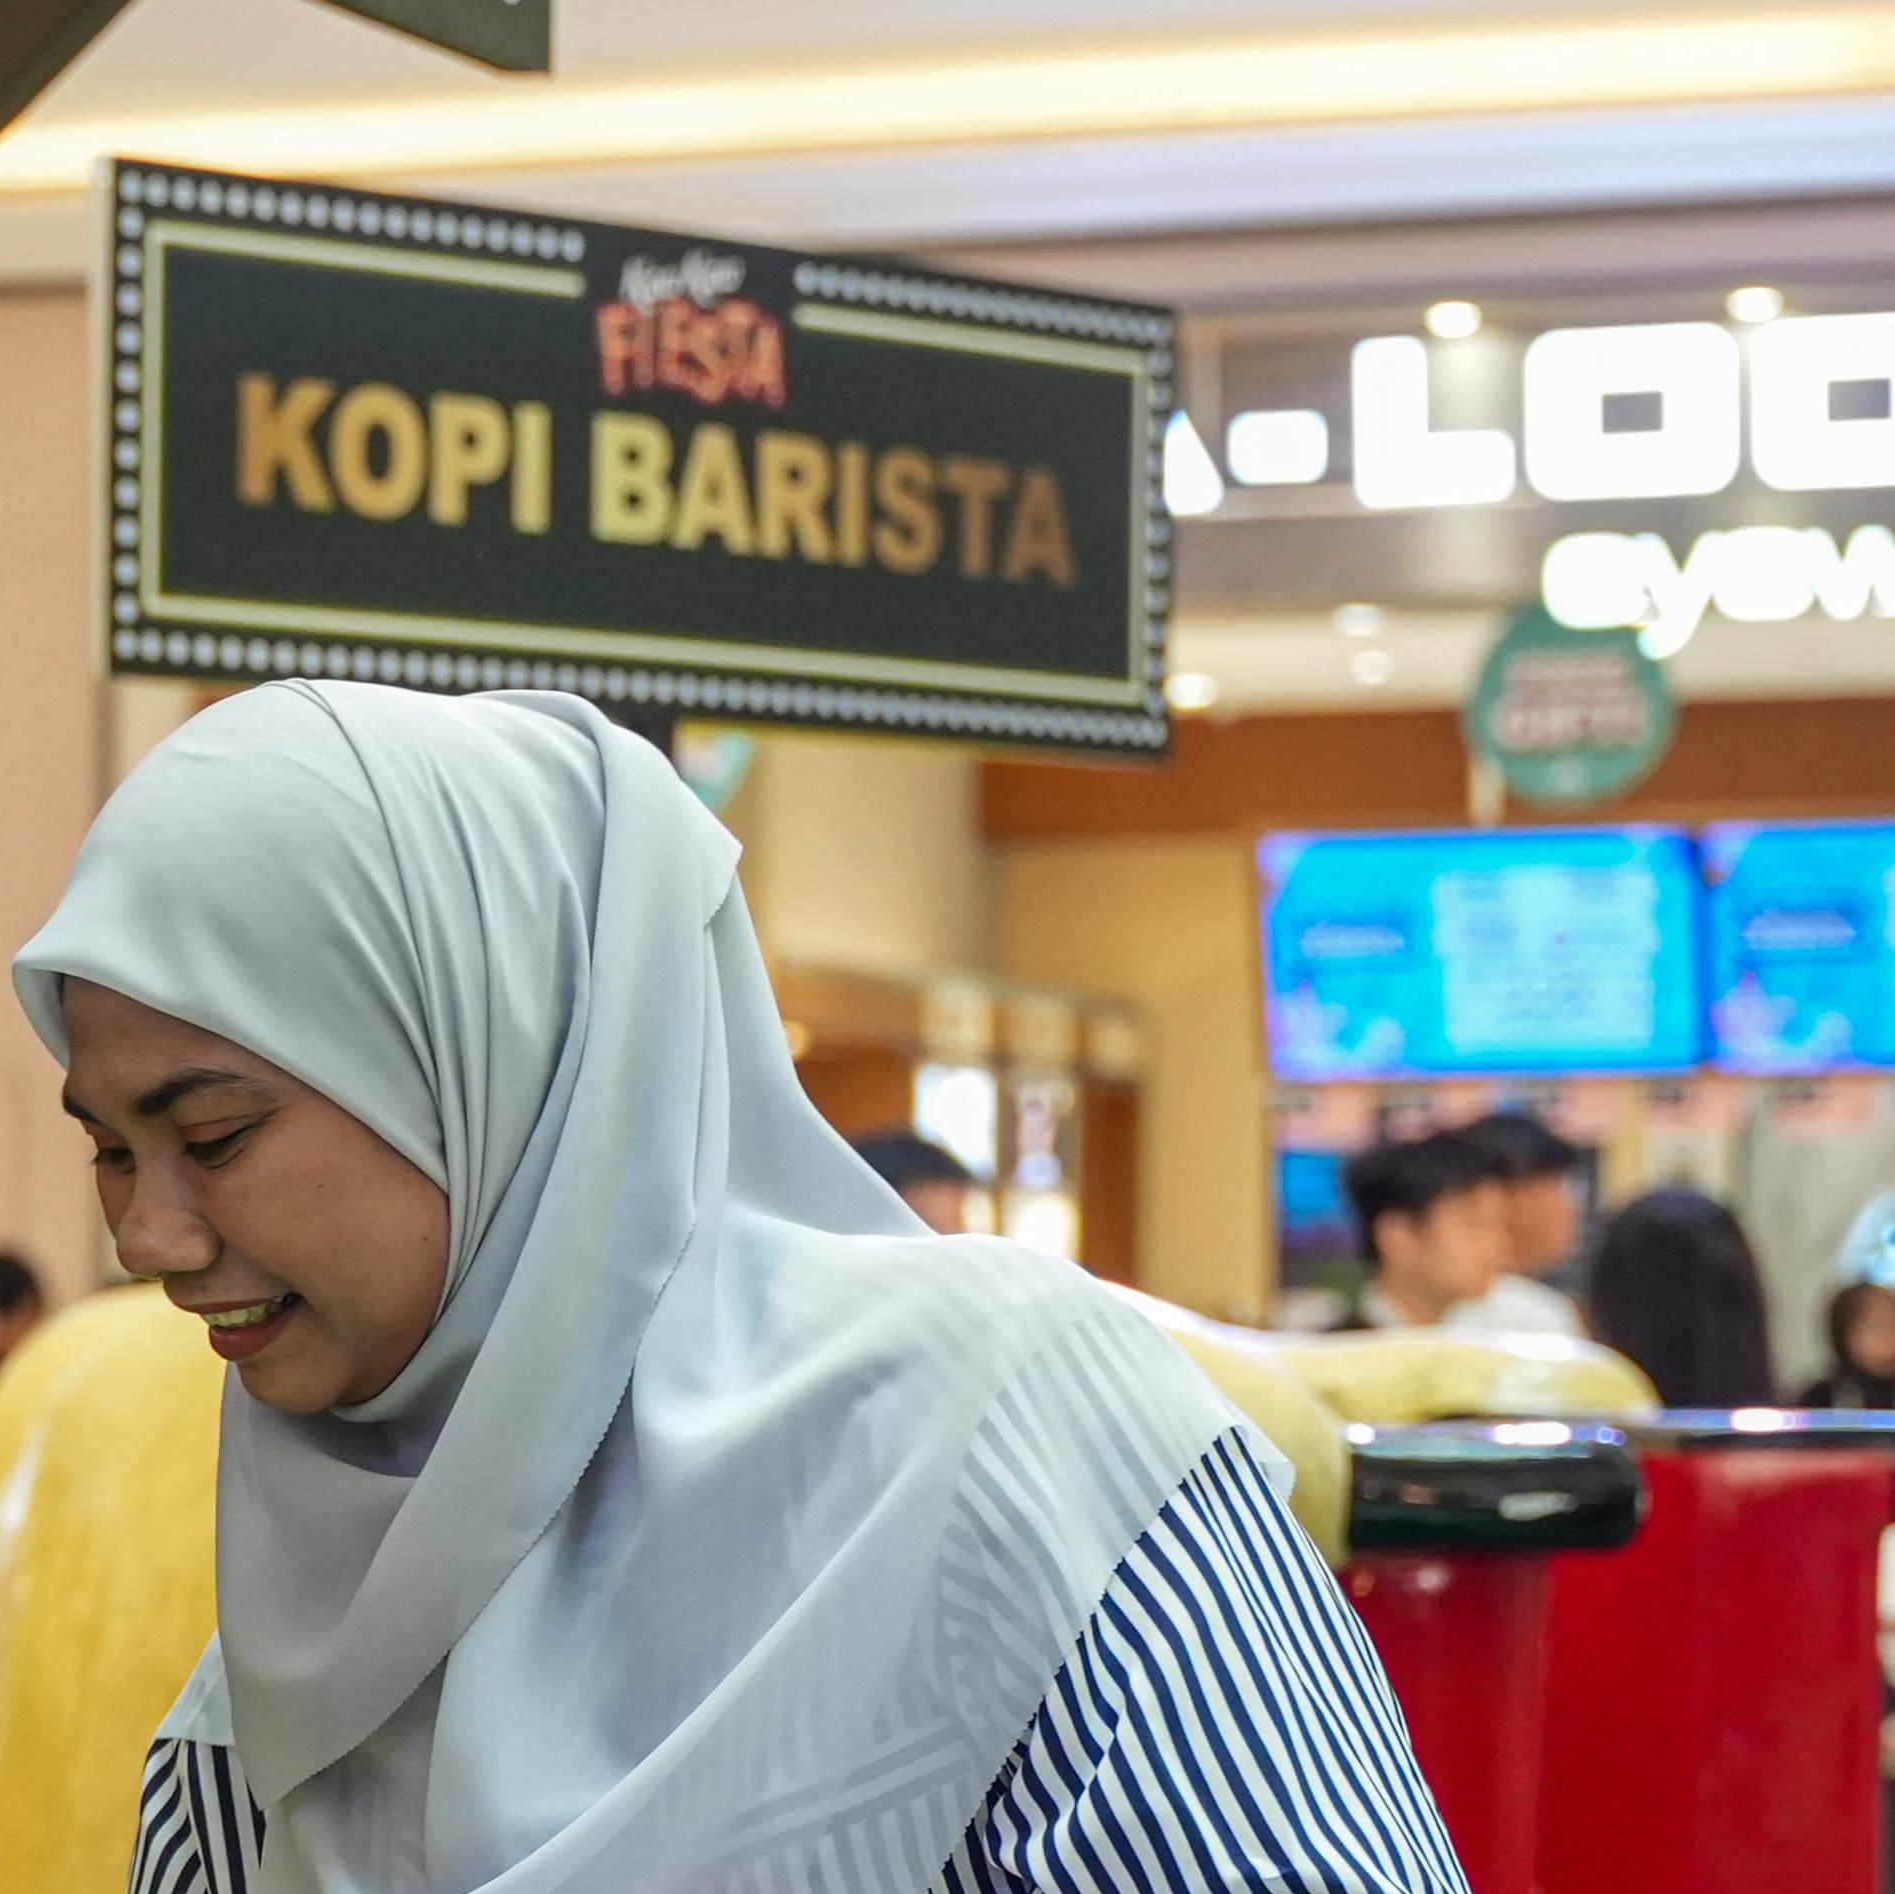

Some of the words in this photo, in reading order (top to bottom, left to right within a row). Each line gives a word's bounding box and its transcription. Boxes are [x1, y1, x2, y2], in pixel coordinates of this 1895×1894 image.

[595, 298, 787, 410] FIESTA
[236, 371, 553, 536] KOPI
[589, 409, 1078, 588] BARISTA
